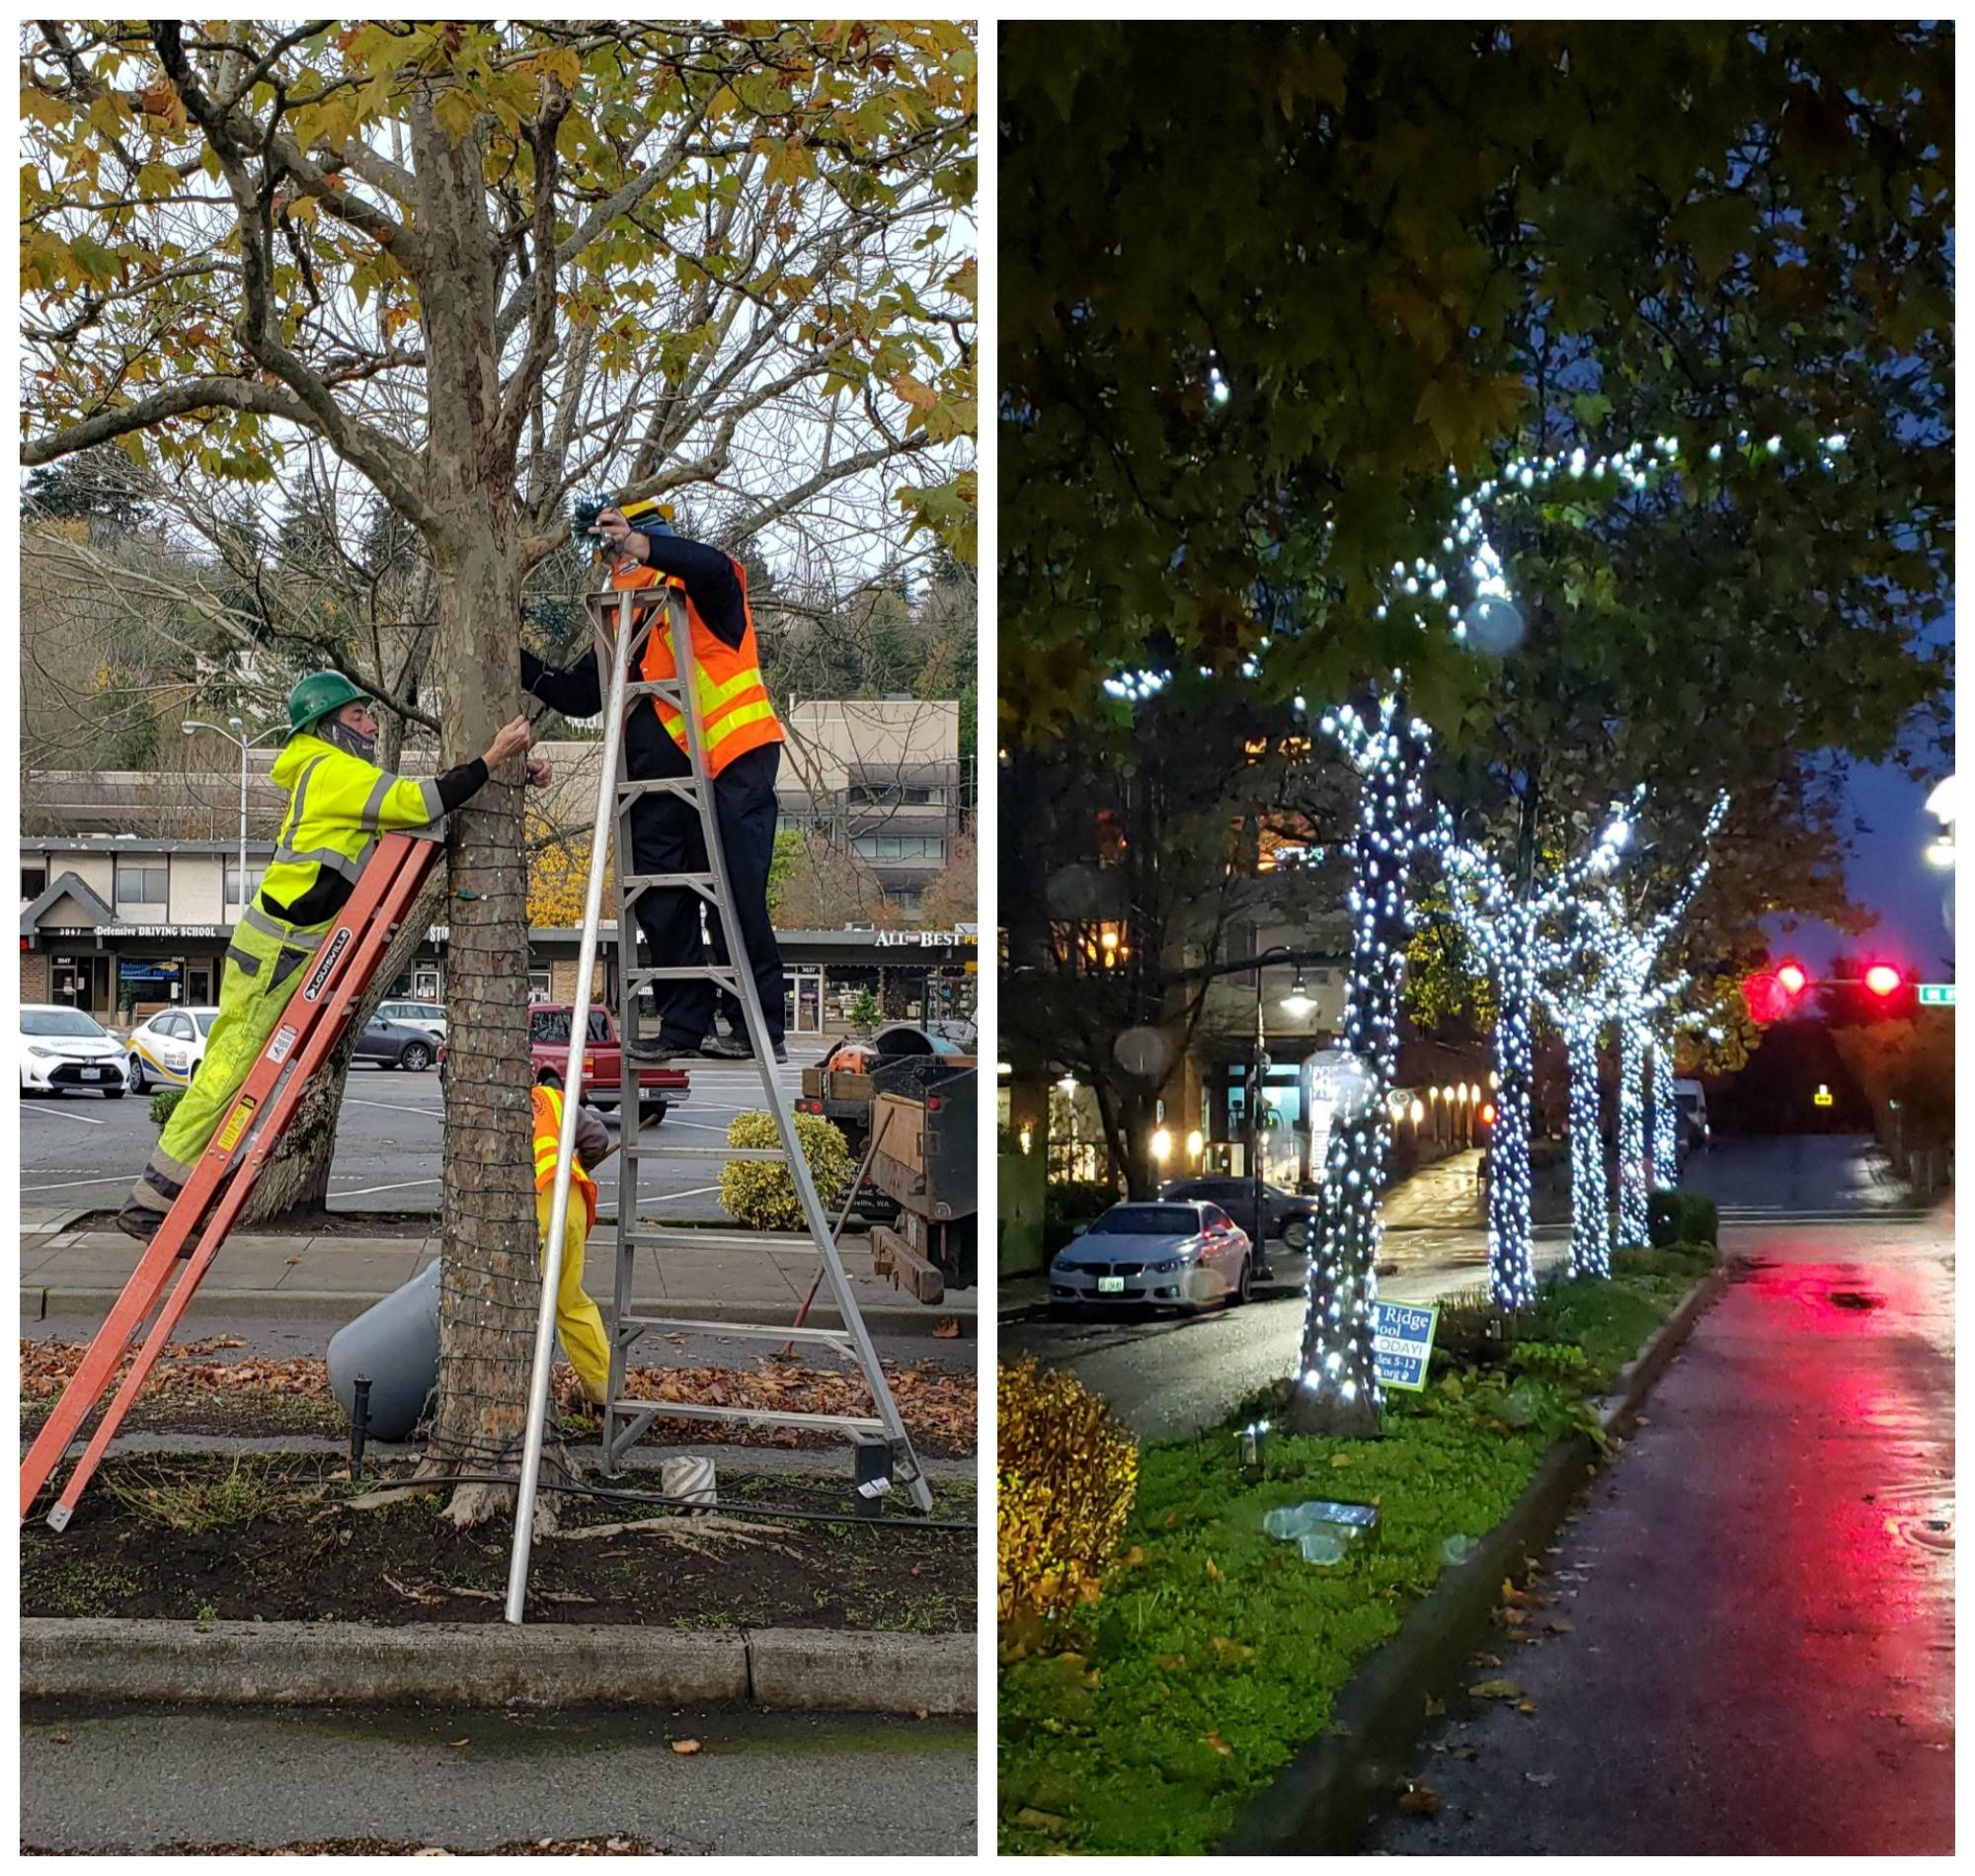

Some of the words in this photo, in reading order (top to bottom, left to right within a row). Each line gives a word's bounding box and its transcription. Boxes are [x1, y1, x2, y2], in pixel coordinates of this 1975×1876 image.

[96, 926, 136, 936] Defensive
[138, 926, 178, 936] DRIVING
[181, 926, 216, 937] SCHOOL
[875, 929, 908, 947] ALL
[920, 931, 963, 947] BEST
[311, 930, 349, 988] LOUISVILLE
[1384, 1306, 1429, 1331] Ridge
[1393, 1357, 1416, 1369] 5-12
